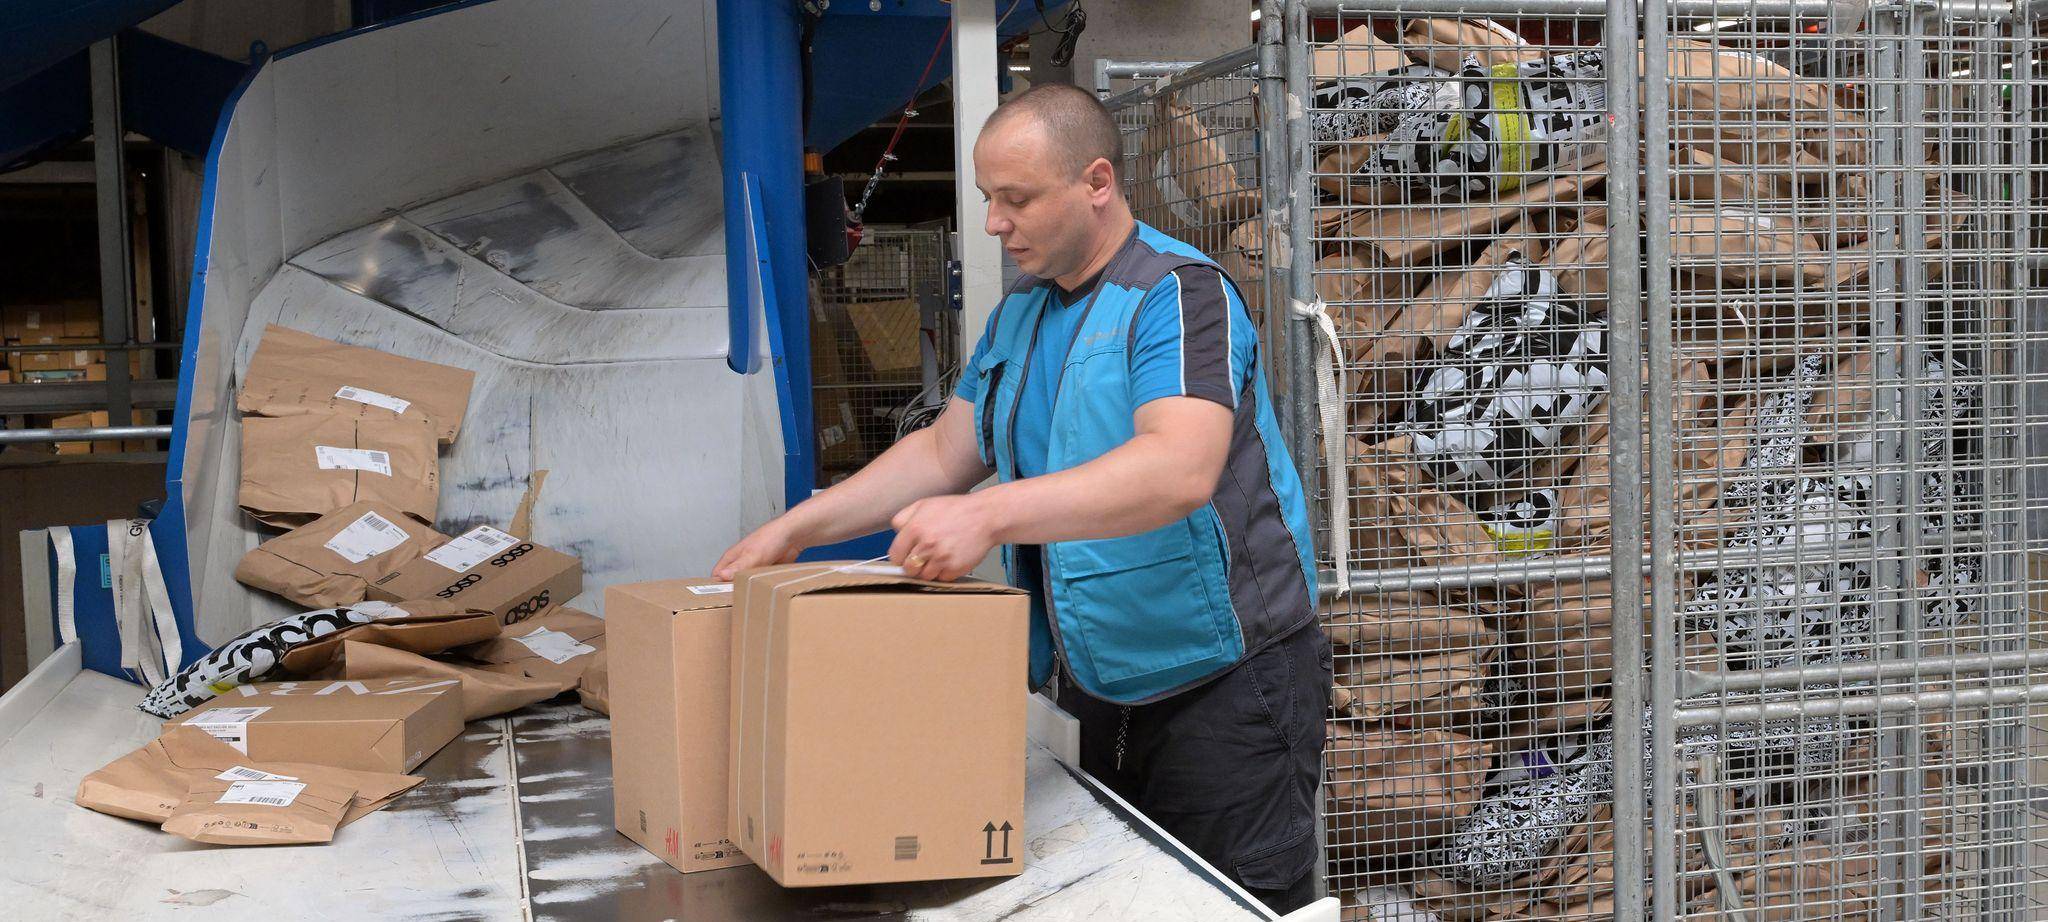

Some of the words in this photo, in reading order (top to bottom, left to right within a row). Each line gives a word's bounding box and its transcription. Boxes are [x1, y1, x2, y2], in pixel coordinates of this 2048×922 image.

[491, 543, 534, 567] asos
[436, 573, 483, 598] asos
[504, 589, 550, 625] asos
